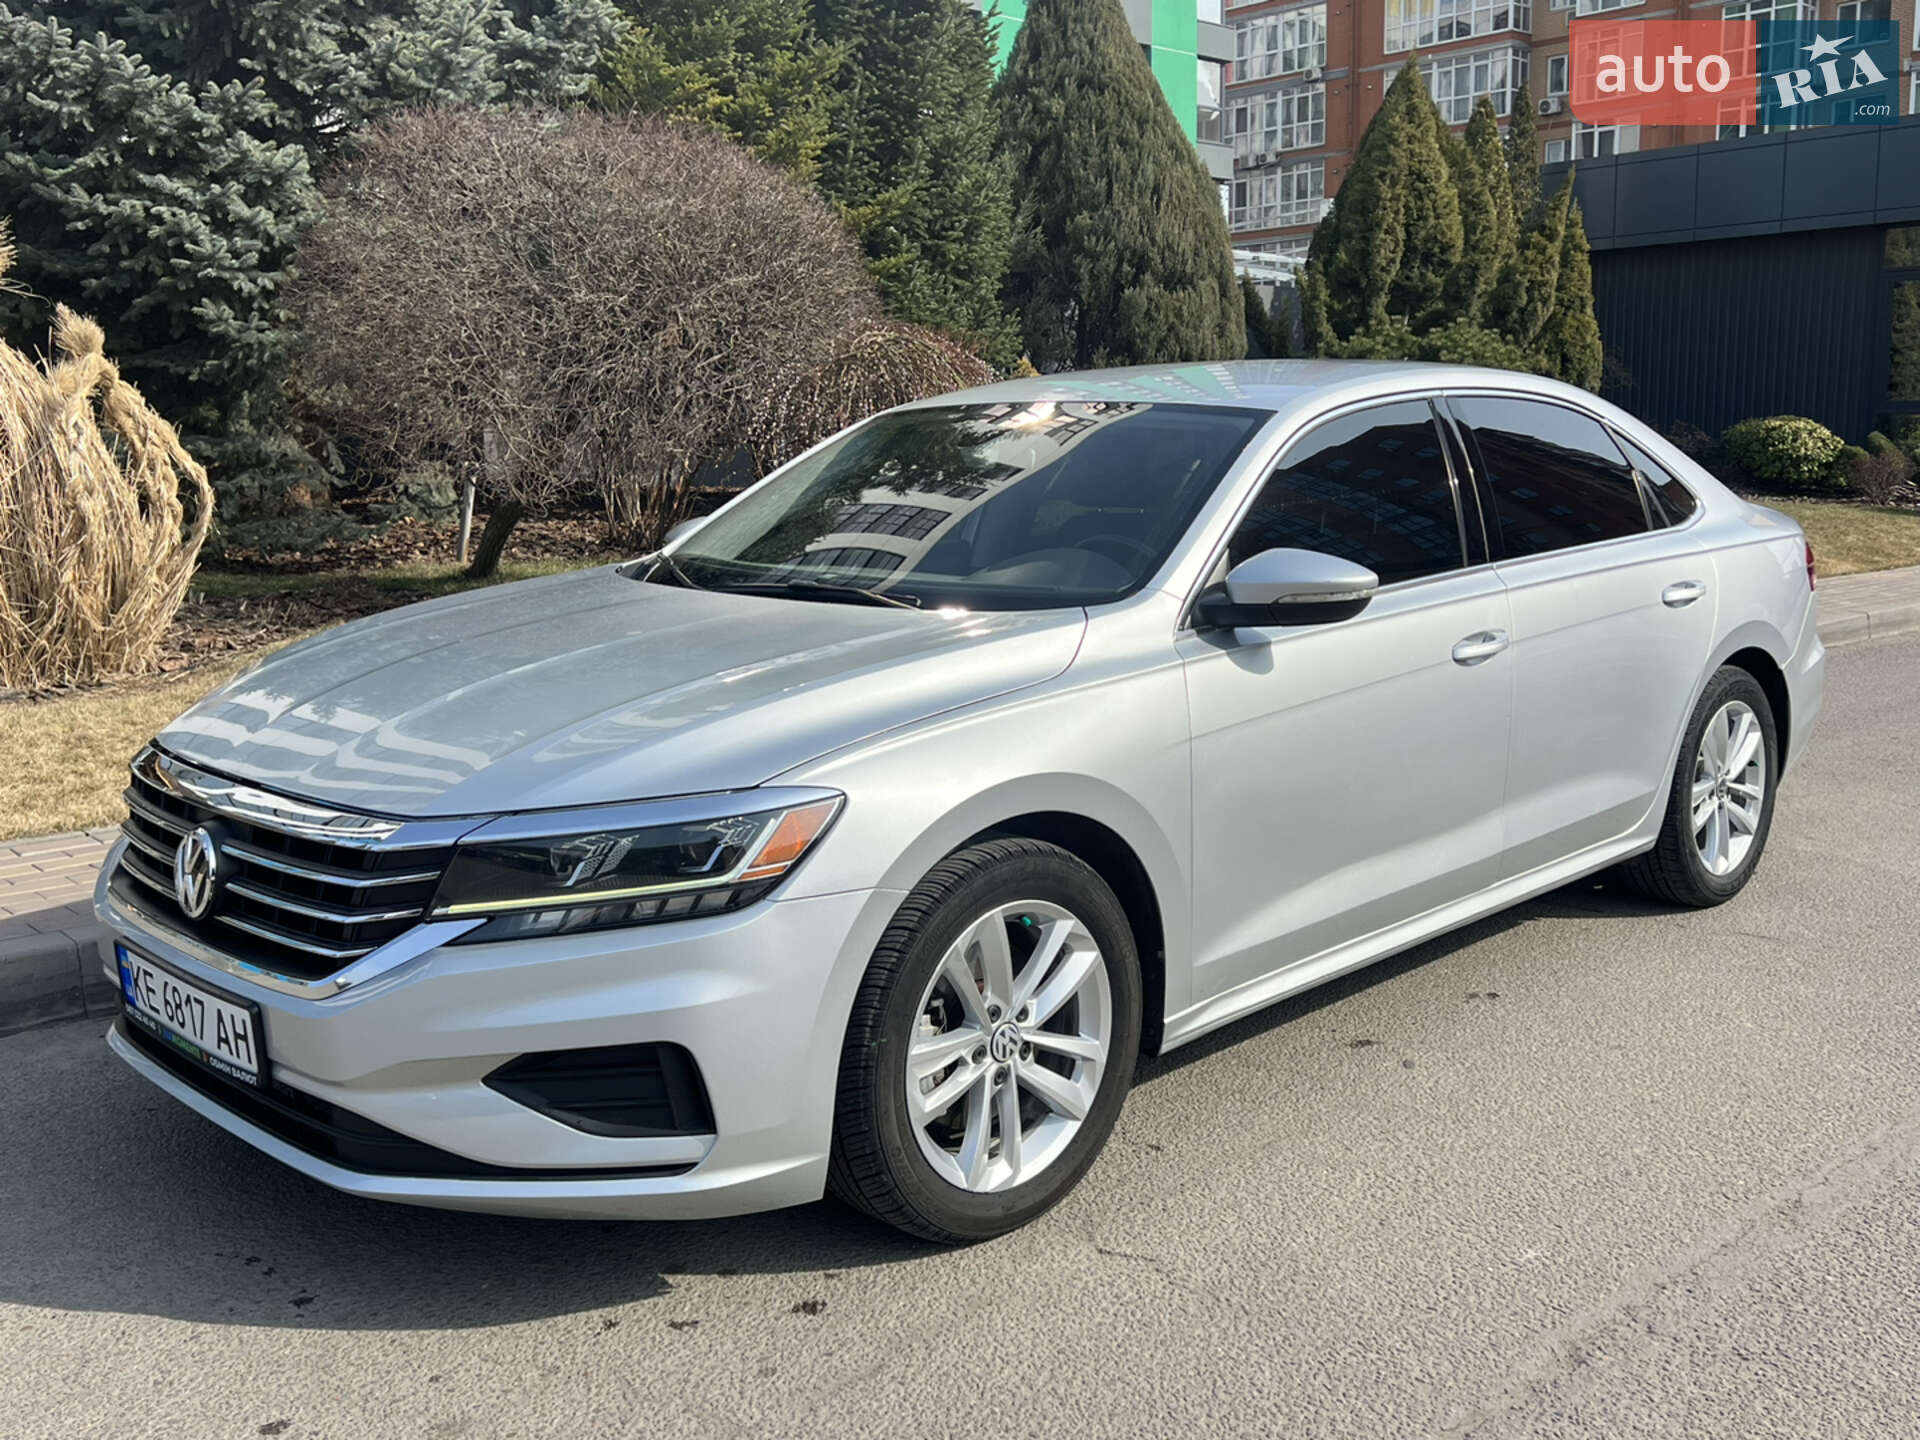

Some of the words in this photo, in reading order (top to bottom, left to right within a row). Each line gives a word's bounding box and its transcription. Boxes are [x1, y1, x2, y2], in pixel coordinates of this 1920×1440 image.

[130, 962, 160, 1015] KE
[164, 981, 205, 1041] 6817
[217, 1008, 252, 1064] AH
